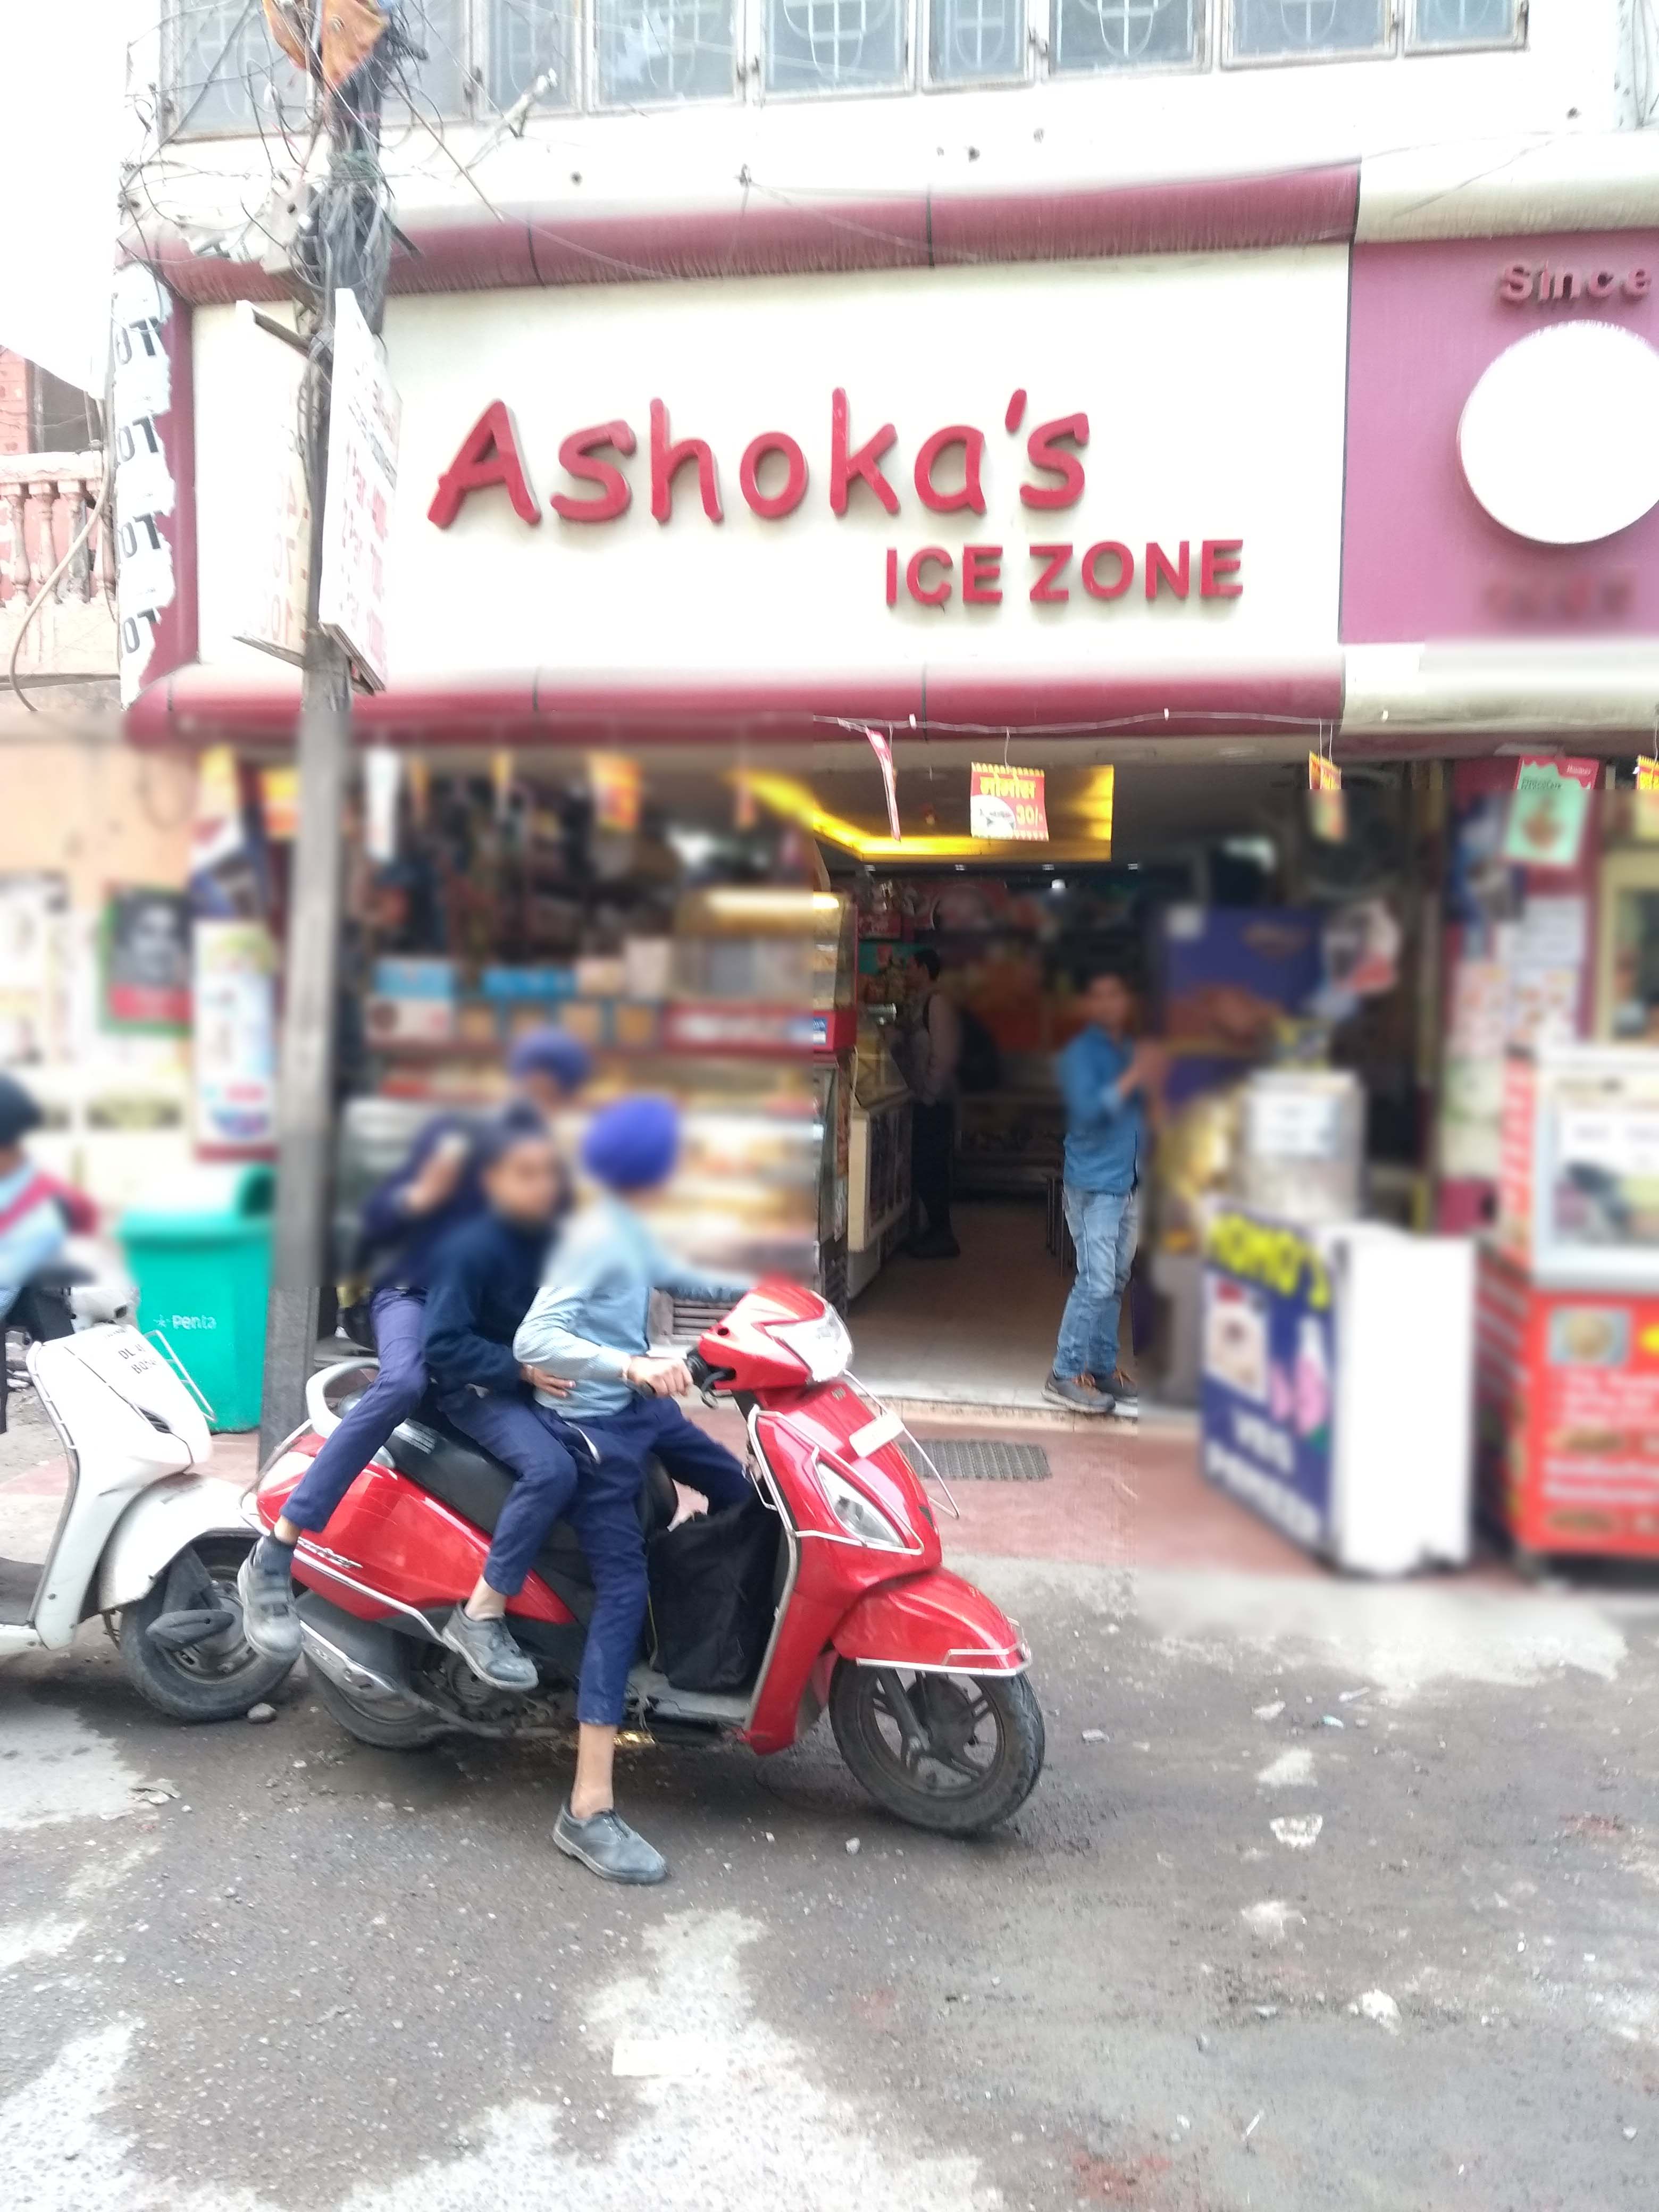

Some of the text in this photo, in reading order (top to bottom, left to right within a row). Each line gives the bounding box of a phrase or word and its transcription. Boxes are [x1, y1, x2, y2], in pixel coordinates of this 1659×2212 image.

[1501, 261, 1652, 299] Since
[428, 388, 1090, 526] Ashoka's
[886, 540, 1243, 606] ICE ZONE
[172, 1314, 217, 1330] Penta
